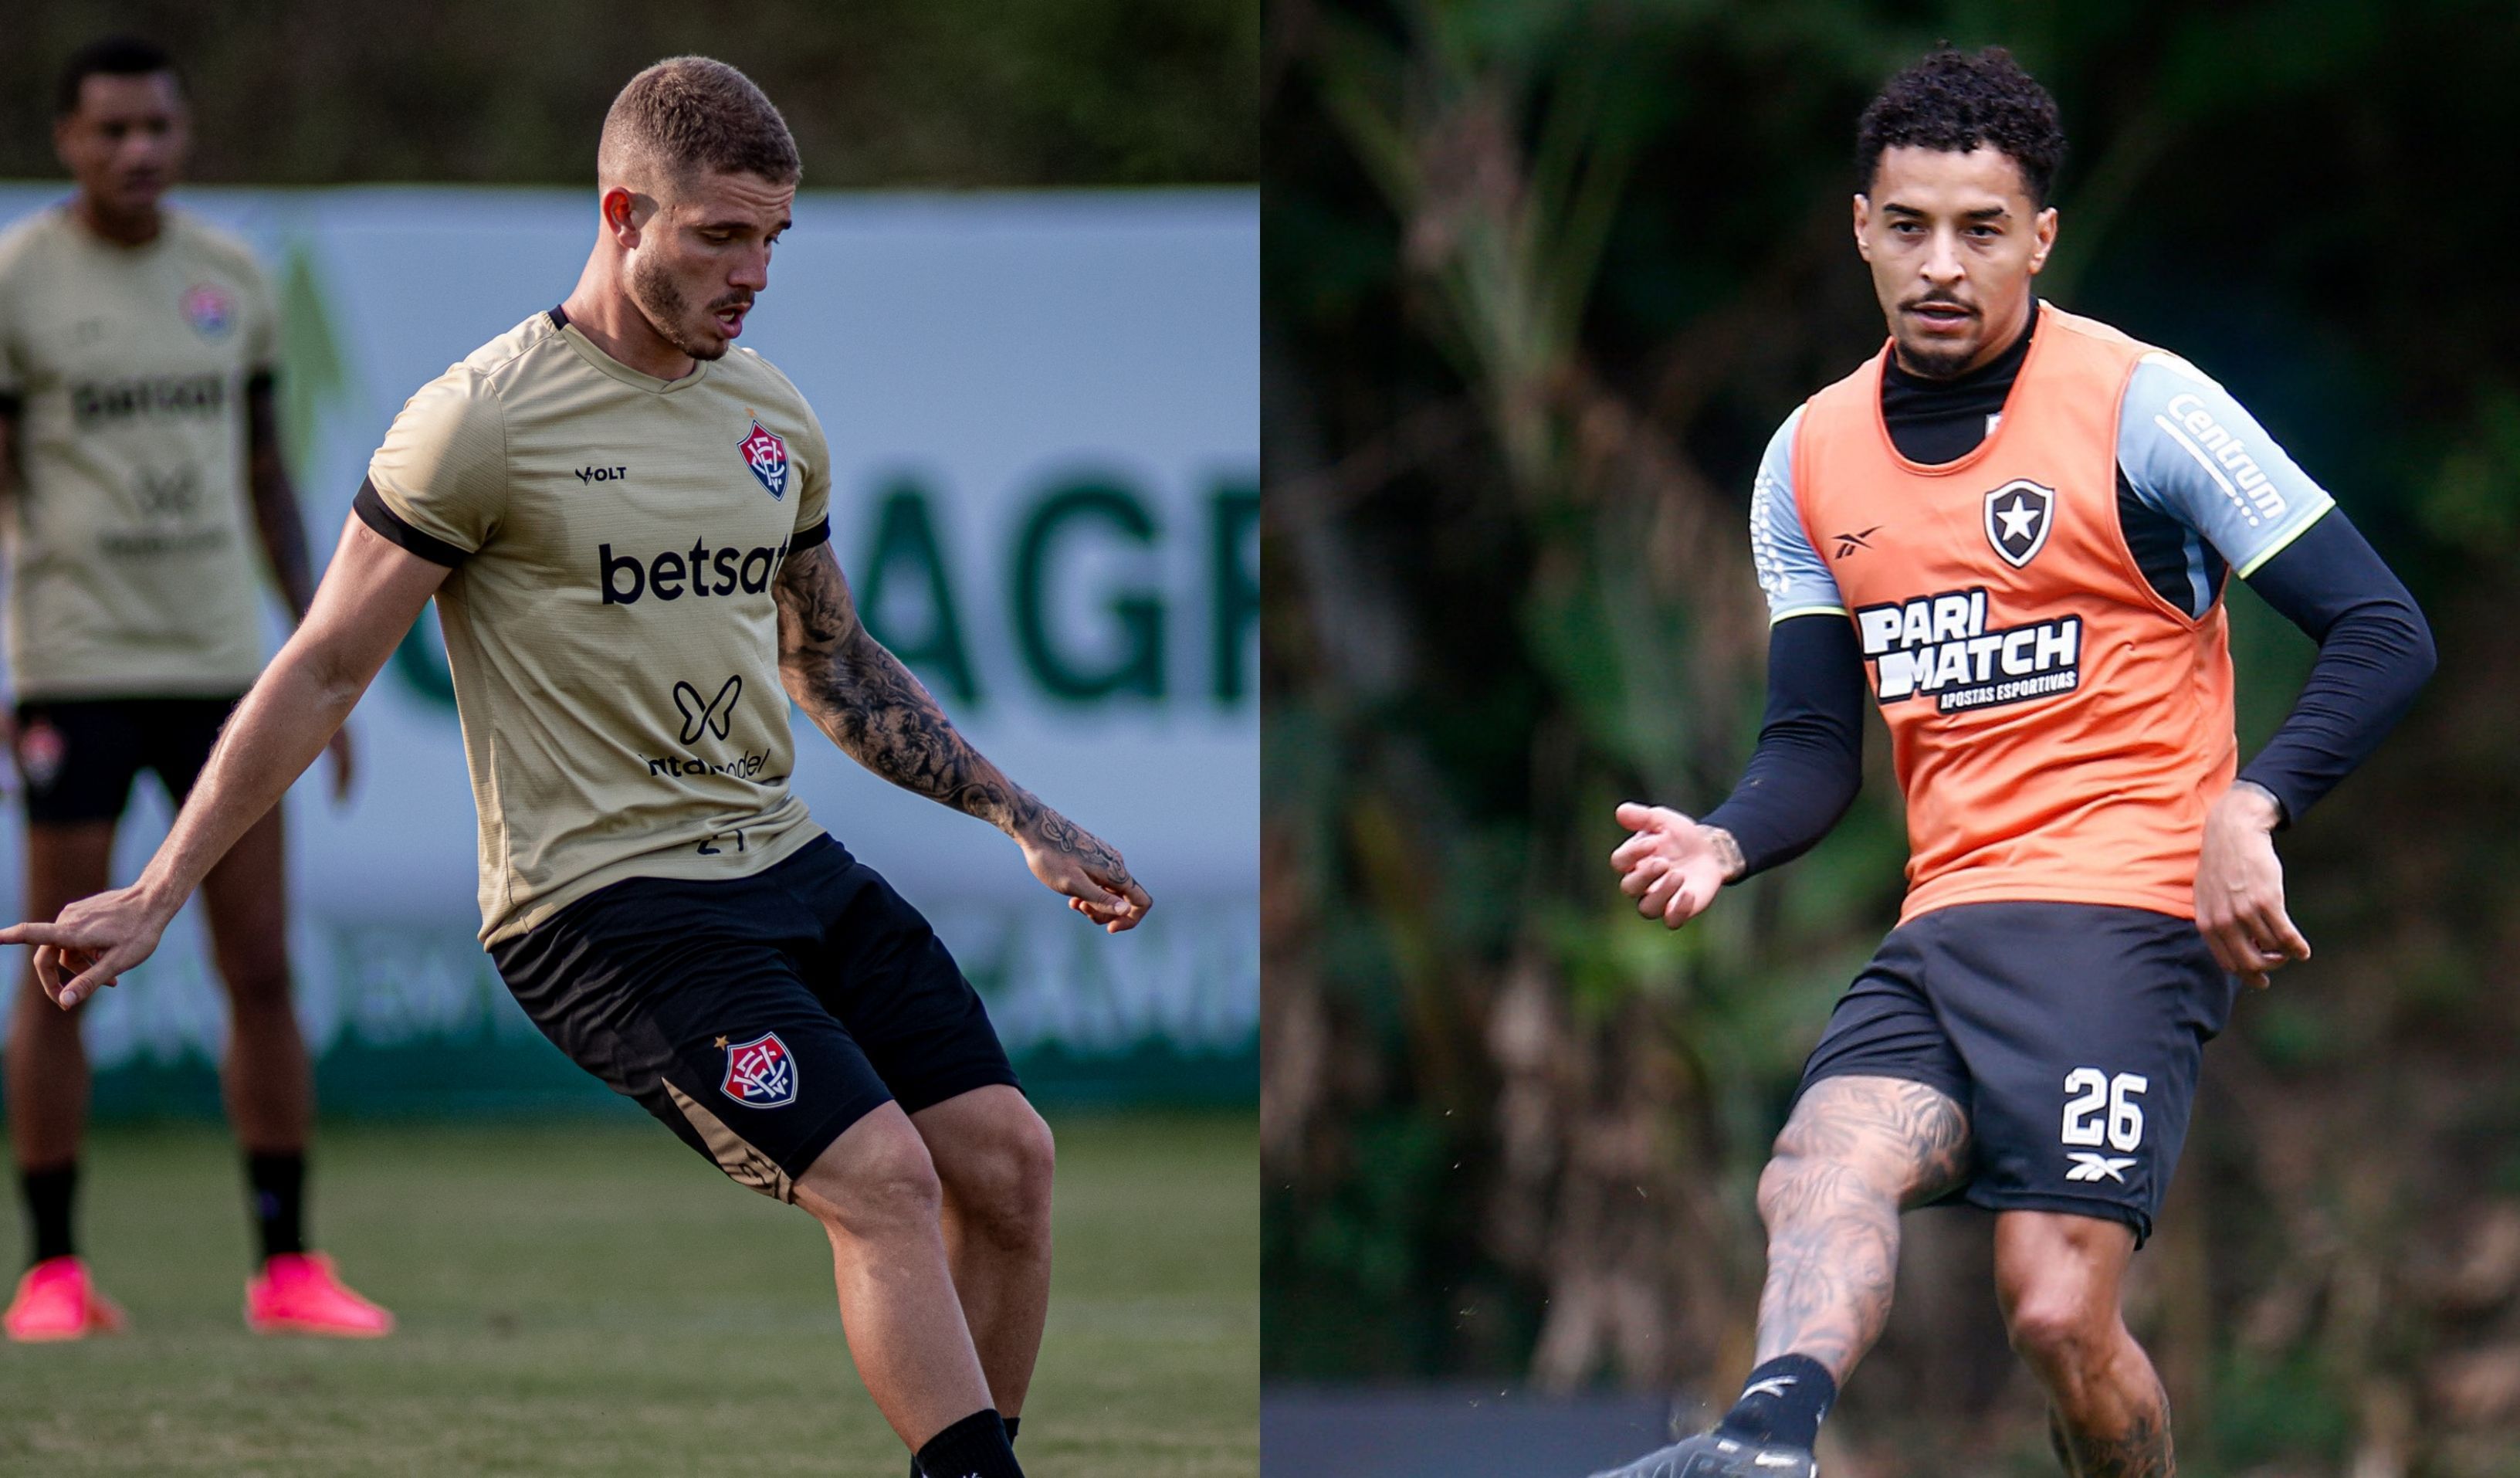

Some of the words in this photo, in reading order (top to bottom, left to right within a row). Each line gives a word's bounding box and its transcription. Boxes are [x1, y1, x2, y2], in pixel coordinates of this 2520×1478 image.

[574, 466, 627, 486] VOLT
[2167, 393, 2287, 520] Centrum
[1858, 592, 1985, 654] PARI
[1878, 620, 2078, 698] MATCH
[1940, 686, 1996, 710] APOSTAS
[1997, 670, 2077, 701] ESPORTIVAS
[2061, 1067, 2148, 1153] 26
